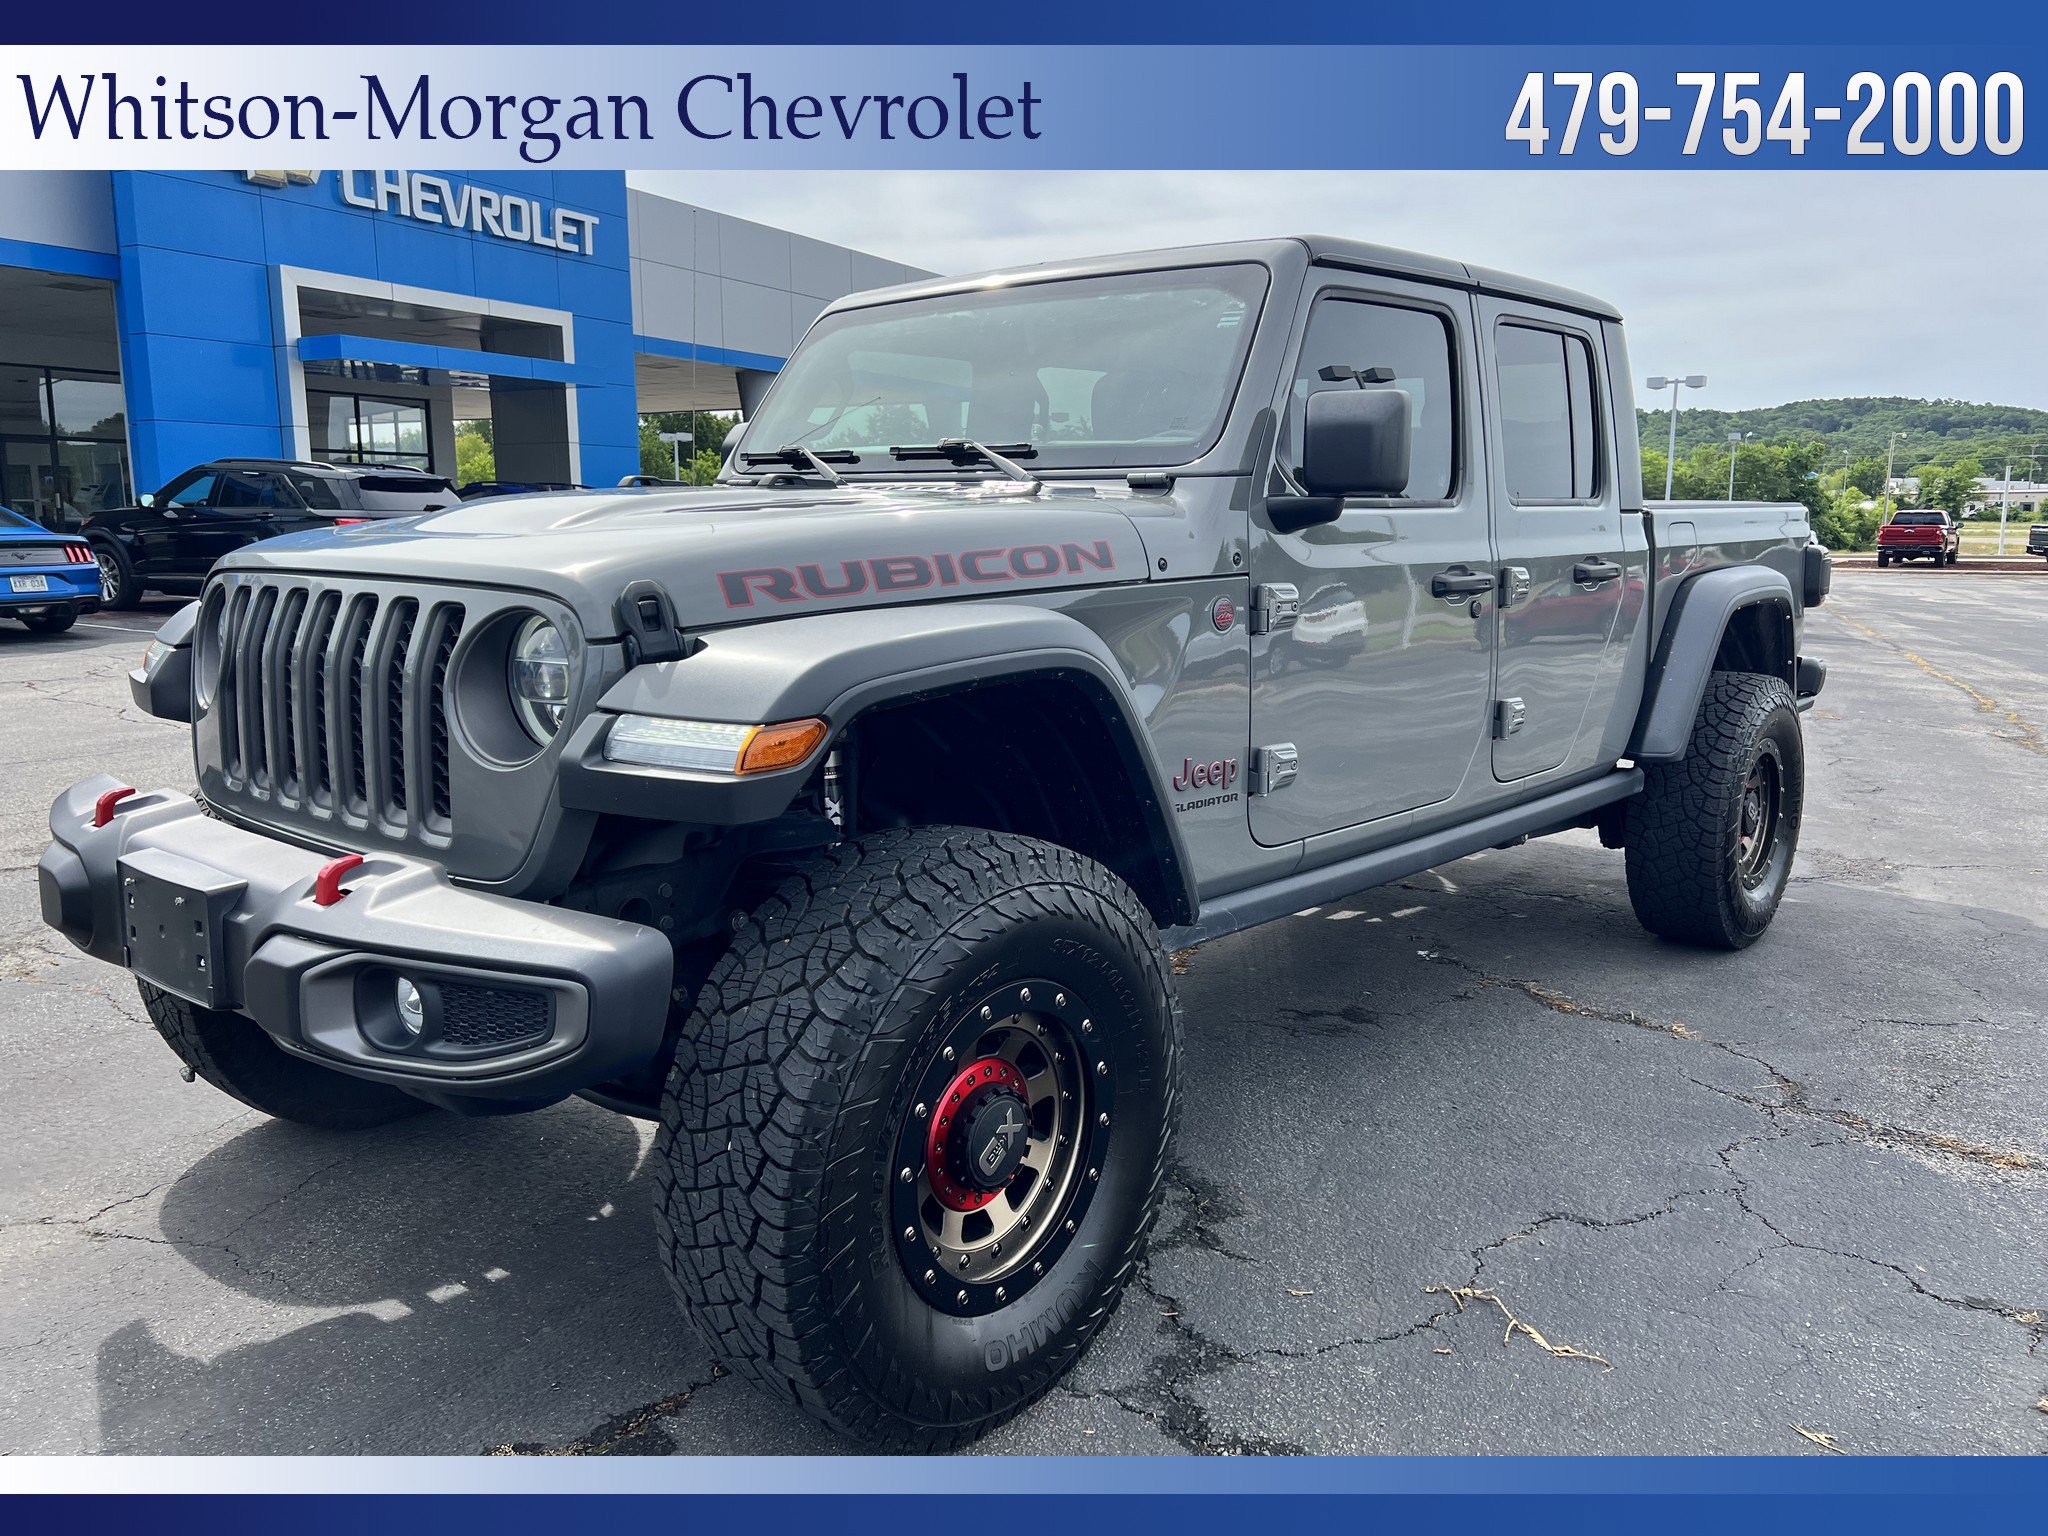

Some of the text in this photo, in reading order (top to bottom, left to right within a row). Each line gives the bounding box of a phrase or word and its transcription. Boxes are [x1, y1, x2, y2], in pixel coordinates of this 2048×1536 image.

[341, 170, 600, 256] CHEVROLET
[716, 540, 1116, 609] RUBICON
[1173, 757, 1240, 792] Jeep
[984, 1258, 1104, 1372] KUMHO
